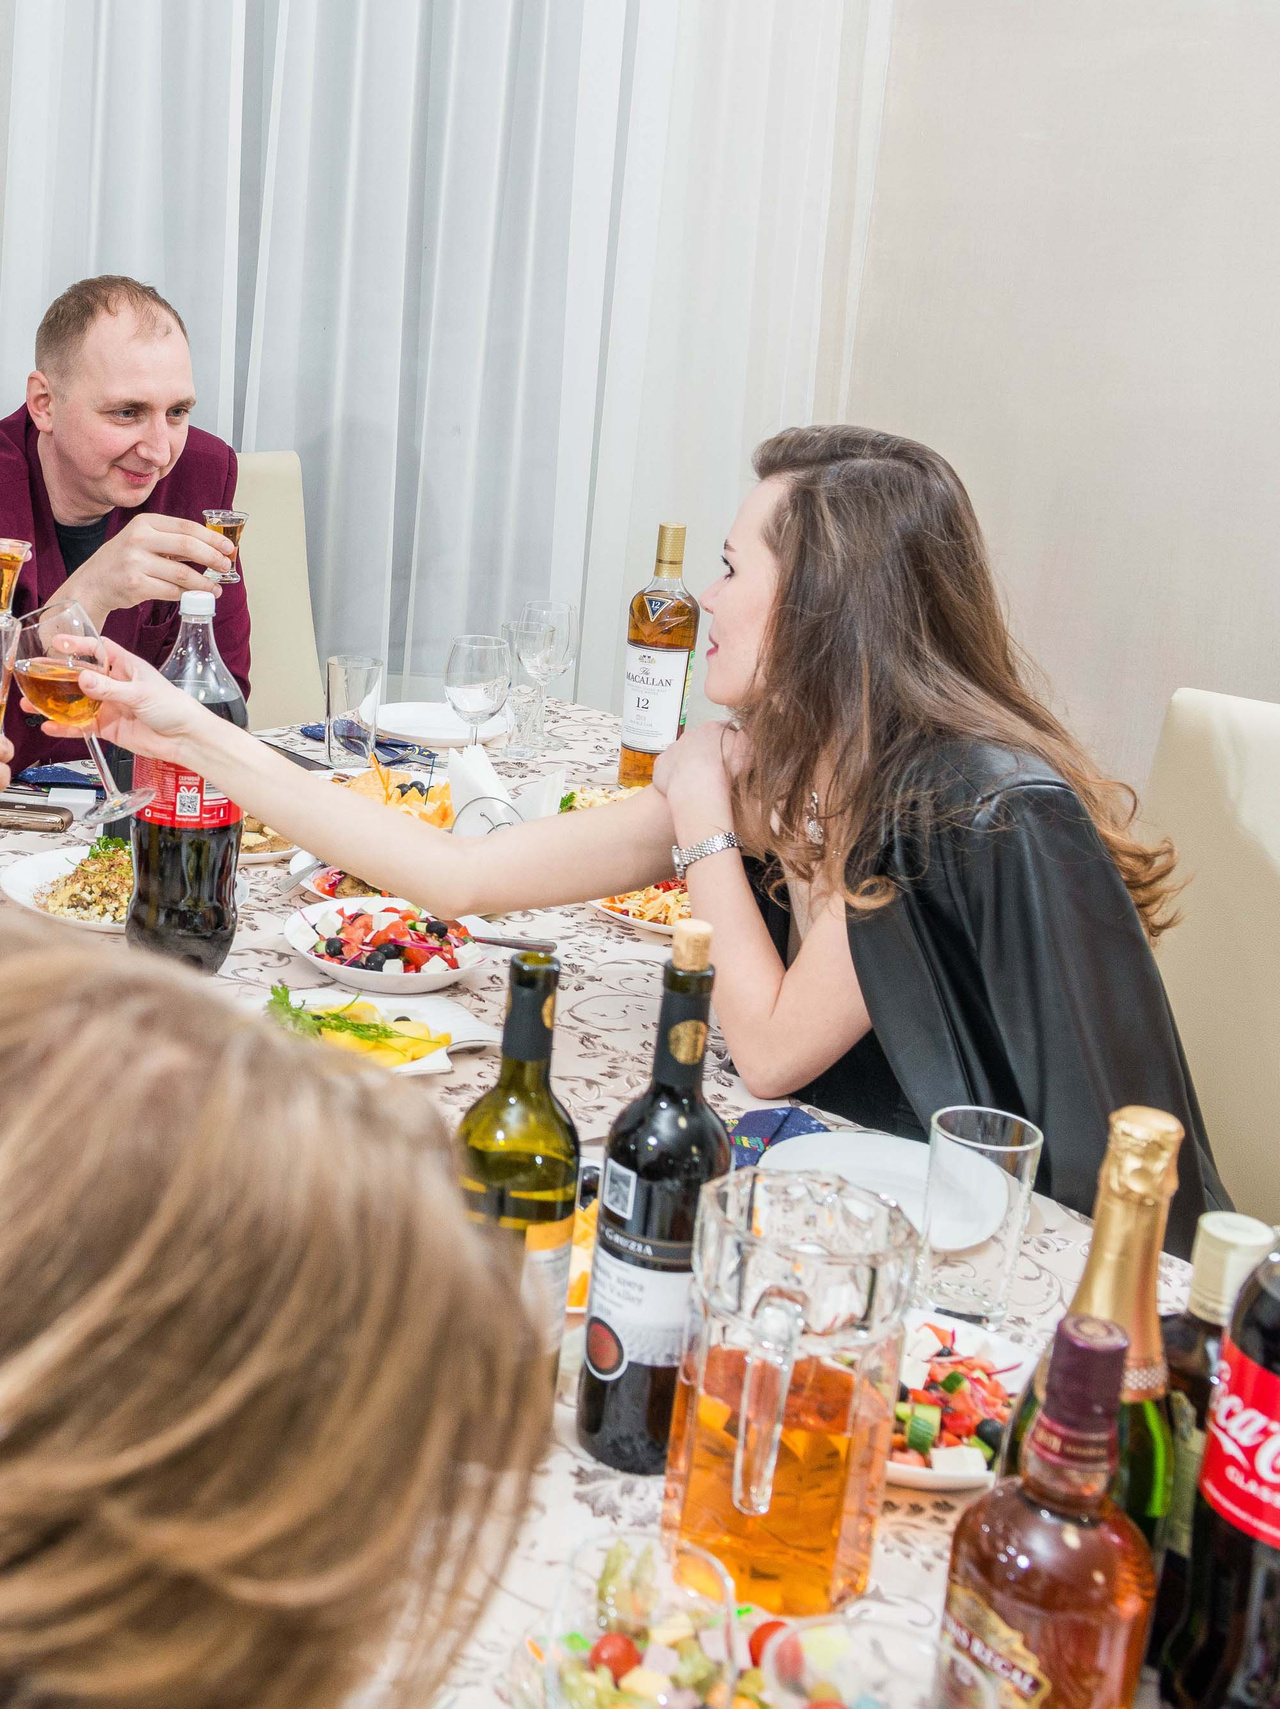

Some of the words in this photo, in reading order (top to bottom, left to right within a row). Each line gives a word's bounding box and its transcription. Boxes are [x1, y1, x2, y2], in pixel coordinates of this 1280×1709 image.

[651, 600, 661, 609] 12
[626, 671, 672, 687] MACALLAN
[635, 696, 650, 710] 12
